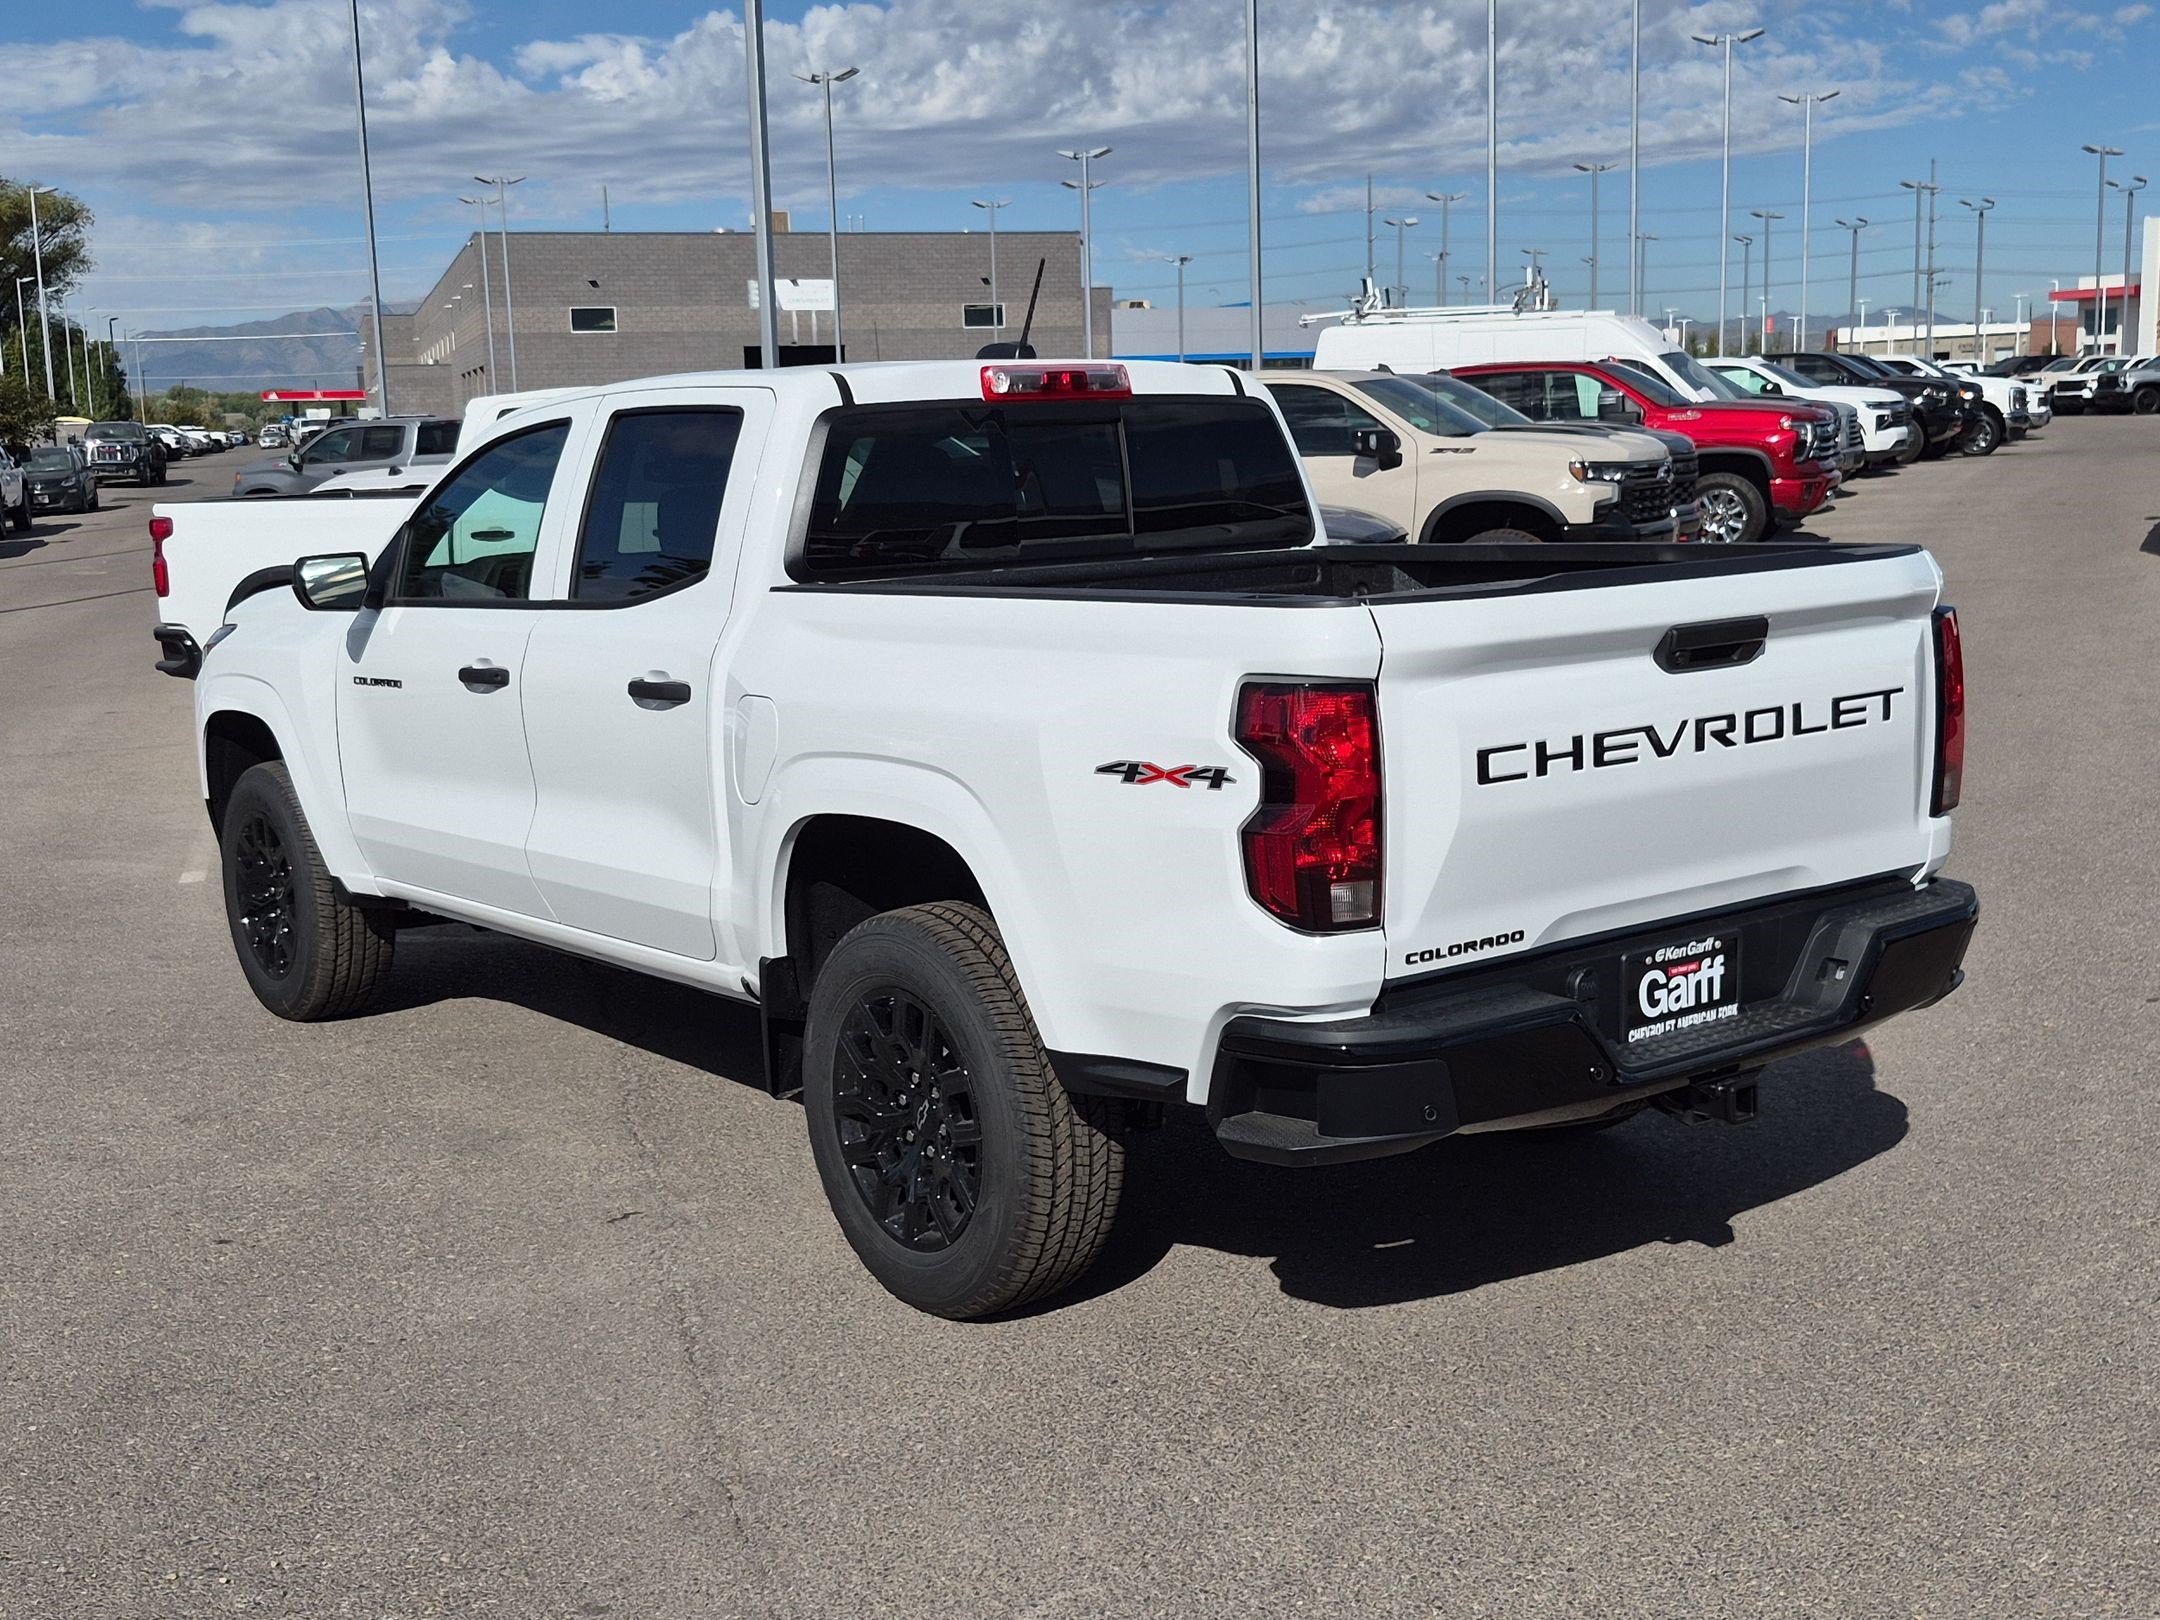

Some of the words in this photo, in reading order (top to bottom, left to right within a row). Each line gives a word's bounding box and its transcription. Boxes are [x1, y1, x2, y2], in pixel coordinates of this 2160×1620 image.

[353, 676, 402, 689] COLORADO
[1476, 686, 1904, 786] CHEVROLET
[1405, 930, 1525, 965] COLORADO
[1665, 946, 1687, 961] Ken
[1687, 937, 1715, 956] Garff
[1639, 954, 1725, 1018] Garff
[1628, 1019, 1677, 1043] CHEVROLET
[1676, 1008, 1717, 1028] AMERICAN
[1717, 1003, 1739, 1019] FORK
